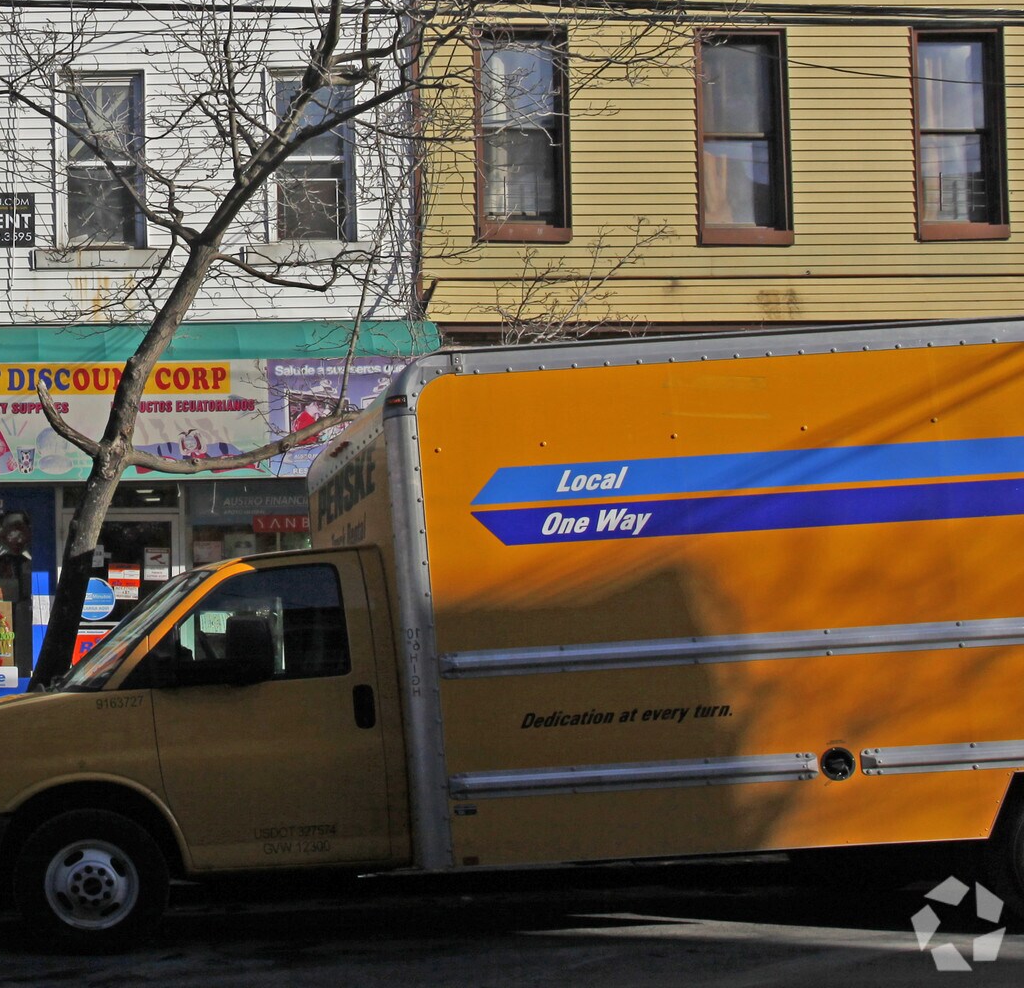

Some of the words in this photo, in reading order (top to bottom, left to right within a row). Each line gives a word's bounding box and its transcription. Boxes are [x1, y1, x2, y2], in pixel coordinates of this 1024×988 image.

[7, 367, 144, 392] DISCOU
[154, 367, 227, 390] CORP
[11, 402, 69, 414] SUPPES
[175, 398, 255, 412] ECUATORIANOS
[556, 466, 628, 492] Local
[541, 512, 590, 535] One
[596, 508, 652, 535] Way
[96, 695, 144, 710] 9163727
[521, 709, 615, 729] Dedication
[619, 708, 637, 723] at
[642, 707, 689, 724] every
[694, 704, 733, 718] turn.
[254, 825, 296, 840] USDOT
[263, 842, 293, 854] GVW
